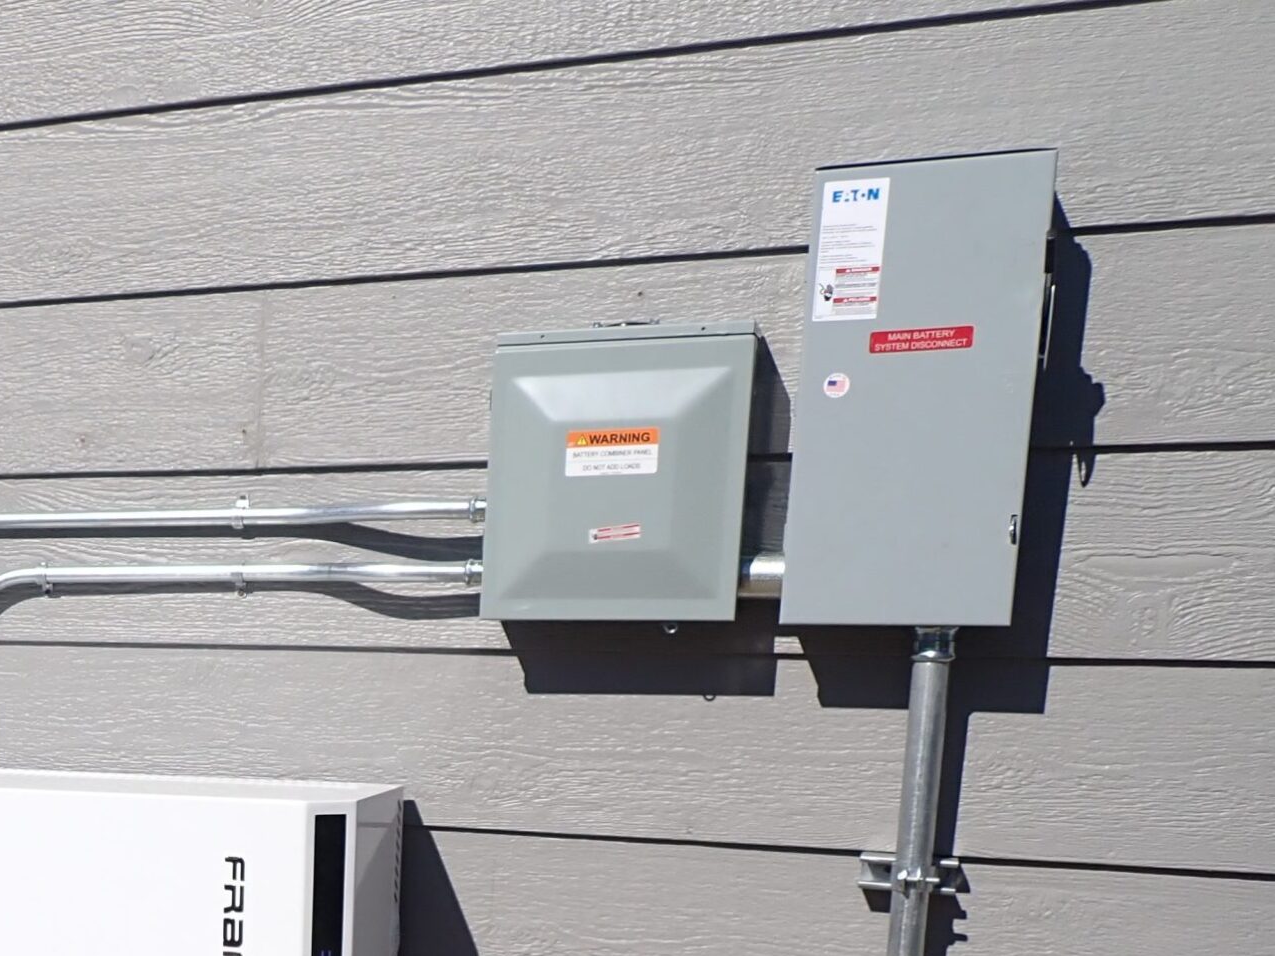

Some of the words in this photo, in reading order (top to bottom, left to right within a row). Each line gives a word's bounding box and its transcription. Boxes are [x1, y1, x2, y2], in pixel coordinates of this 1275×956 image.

[887, 332, 911, 341] MAIN
[912, 329, 956, 340] BATTERY
[875, 342, 909, 352] SYSTEM
[910, 338, 968, 351] DISCONNECT
[589, 432, 651, 445] WARNING
